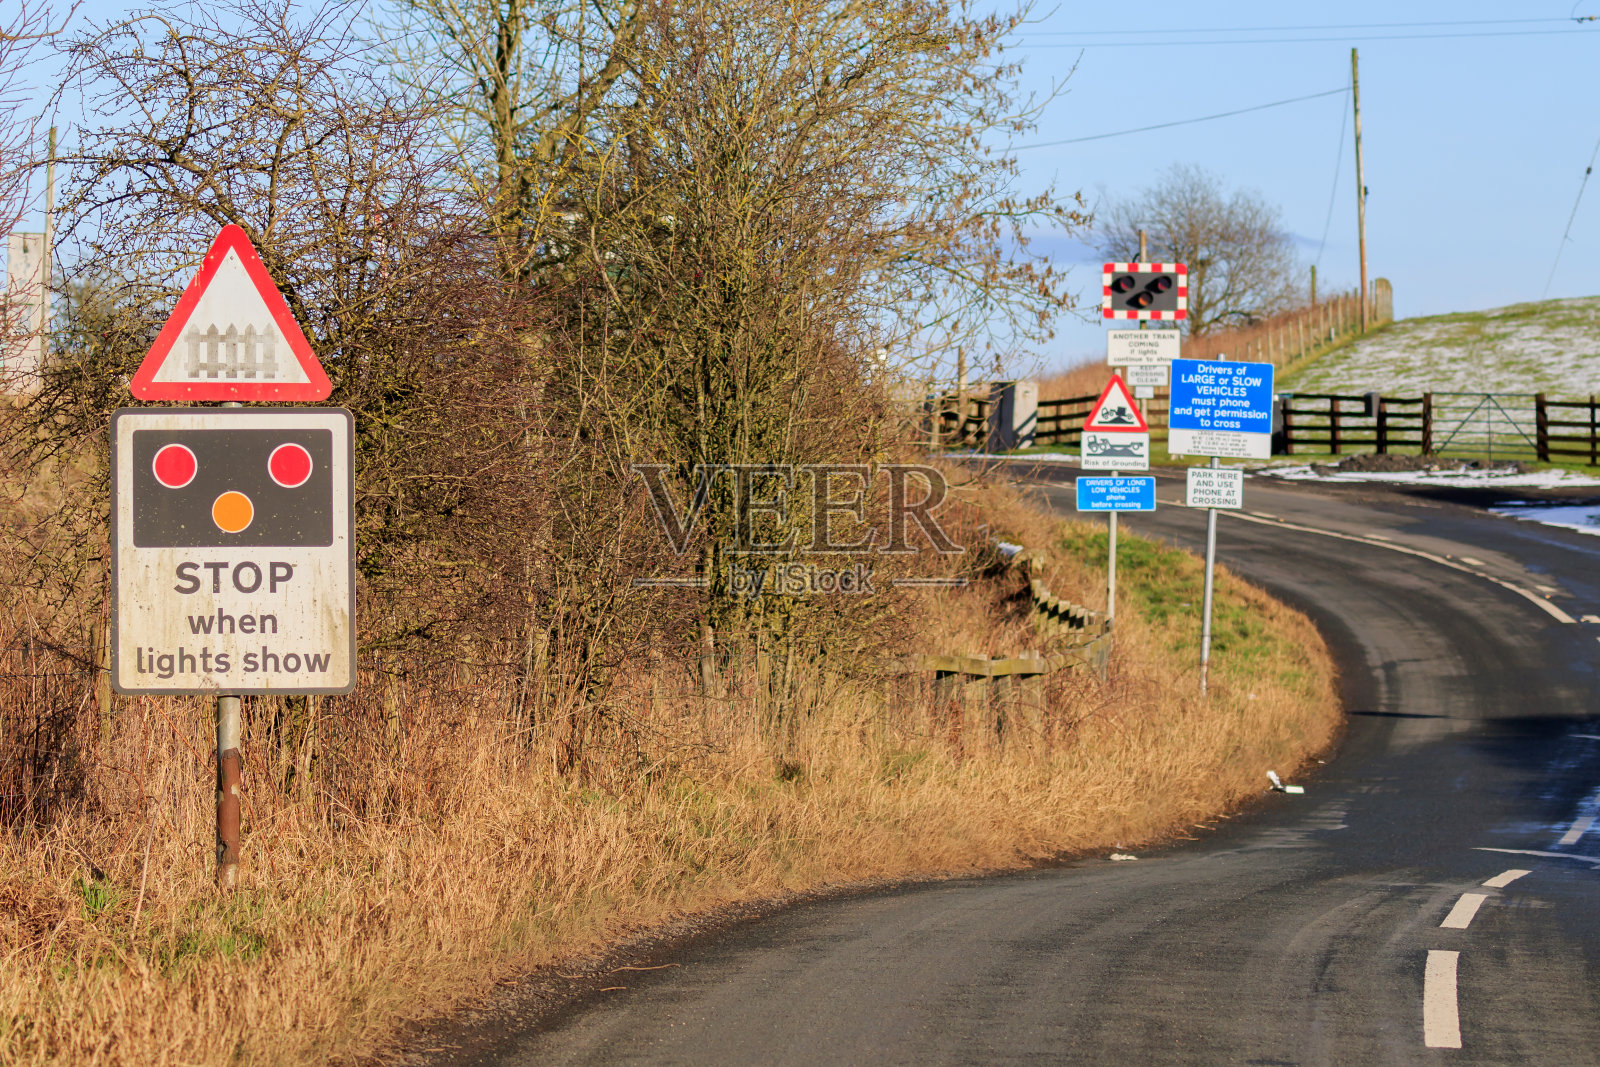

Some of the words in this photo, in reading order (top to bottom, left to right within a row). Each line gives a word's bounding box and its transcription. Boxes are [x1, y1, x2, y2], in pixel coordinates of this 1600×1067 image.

[1198, 364, 1232, 375] Drivers
[1236, 367, 1246, 375] of
[1182, 374, 1215, 384] LARGE
[1232, 377, 1262, 386] SLOW
[1197, 386, 1247, 396] VEHICLES
[1192, 398, 1216, 406] must
[1220, 398, 1250, 407] phone
[1194, 408, 1211, 417] get
[1214, 409, 1268, 419] permission
[1200, 418, 1211, 426] to
[1112, 460, 1147, 468] Grounding
[1192, 497, 1237, 505] CROSSING
[174, 561, 293, 594] STOP
[188, 608, 278, 634] when
[137, 647, 230, 679] lights
[243, 646, 331, 673] show
